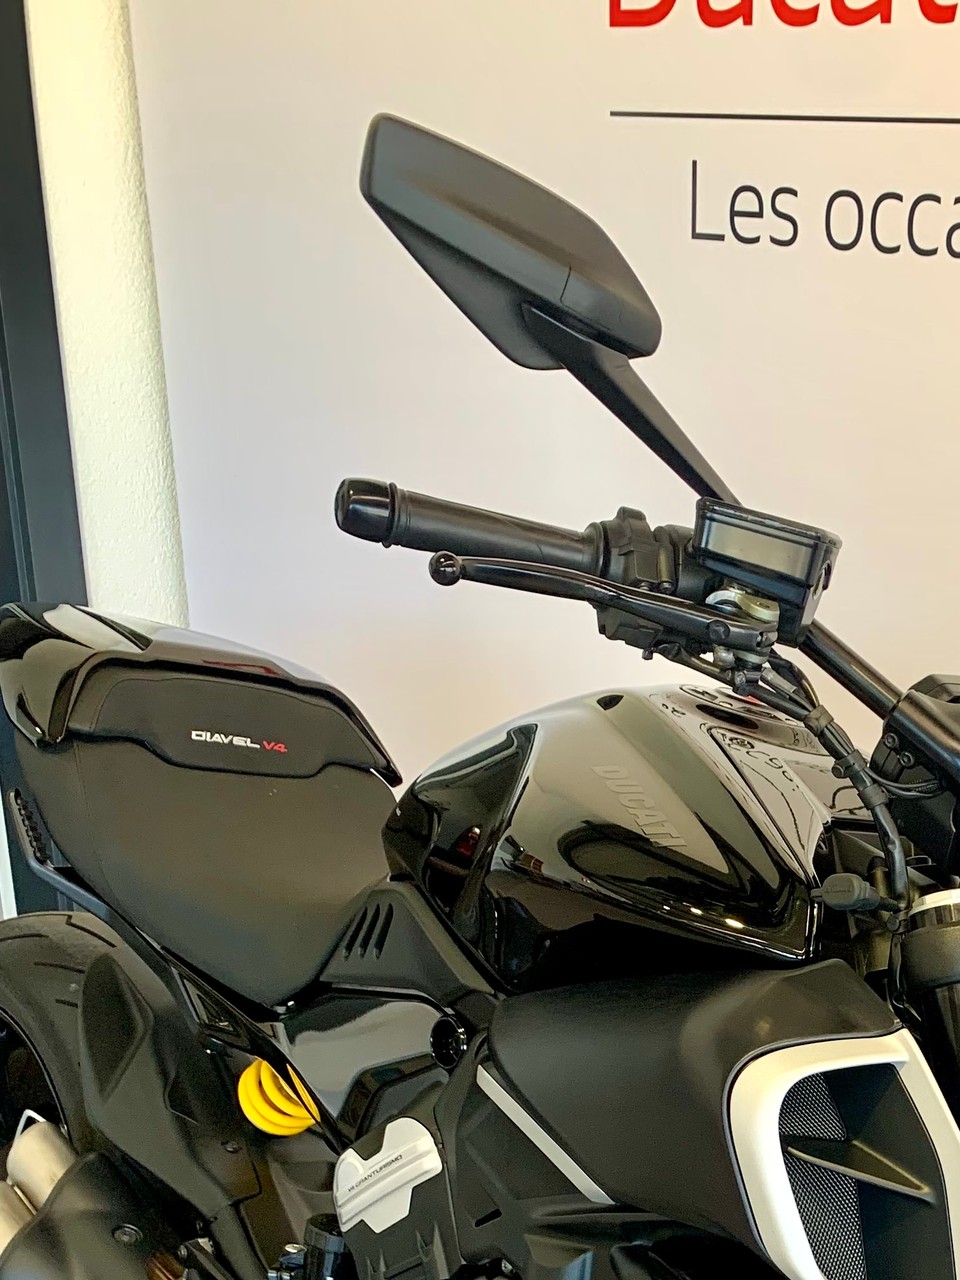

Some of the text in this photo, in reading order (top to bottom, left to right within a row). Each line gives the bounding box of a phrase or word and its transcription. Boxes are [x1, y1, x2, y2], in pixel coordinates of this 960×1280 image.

[691, 159, 799, 247] Les
[191, 730, 288, 753] DIAVEL V4
[591, 765, 688, 848] DUCATI
